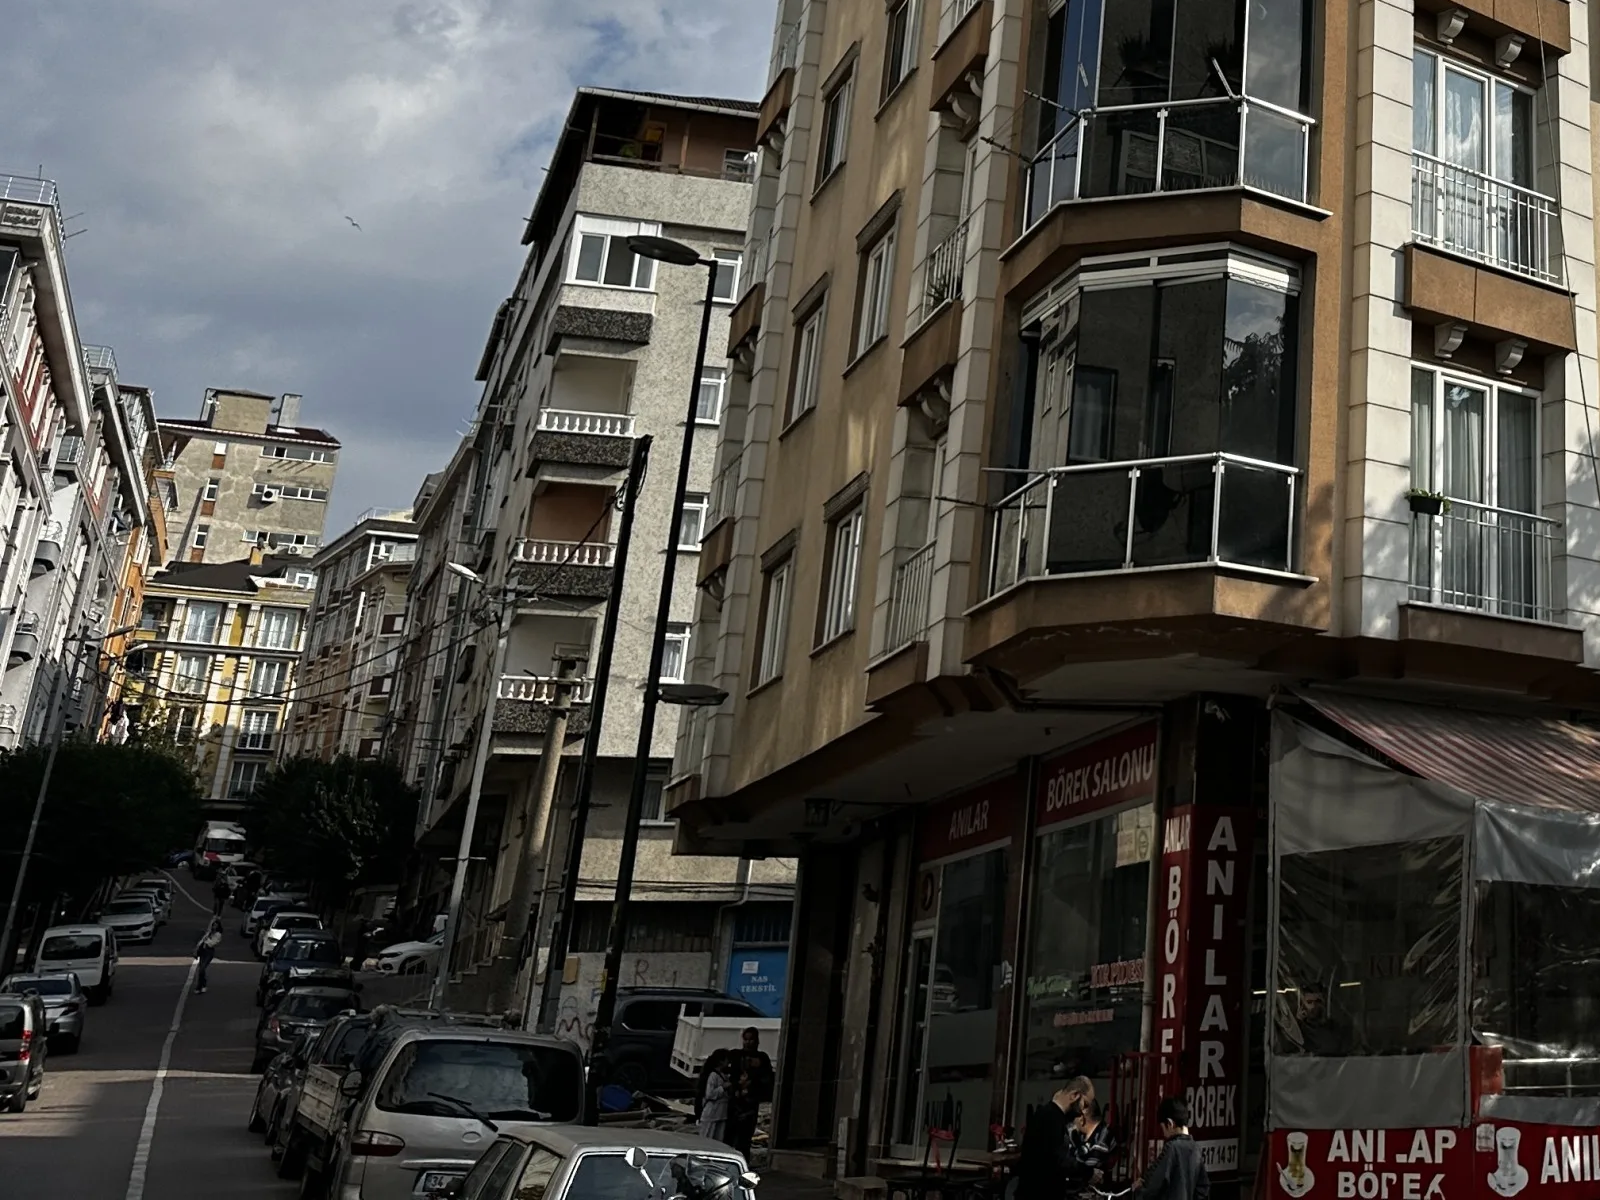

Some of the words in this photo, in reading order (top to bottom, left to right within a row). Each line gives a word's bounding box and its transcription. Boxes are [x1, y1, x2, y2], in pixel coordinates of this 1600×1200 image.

[1046, 764, 1091, 812] BÖREK
[1091, 742, 1155, 798] SALONU
[948, 800, 989, 841] ANILAR
[1159, 866, 1182, 1096] BÖRE
[1198, 816, 1238, 1079] ANILAR
[1217, 1146, 1226, 1164] 14
[1227, 1145, 1237, 1164] 37
